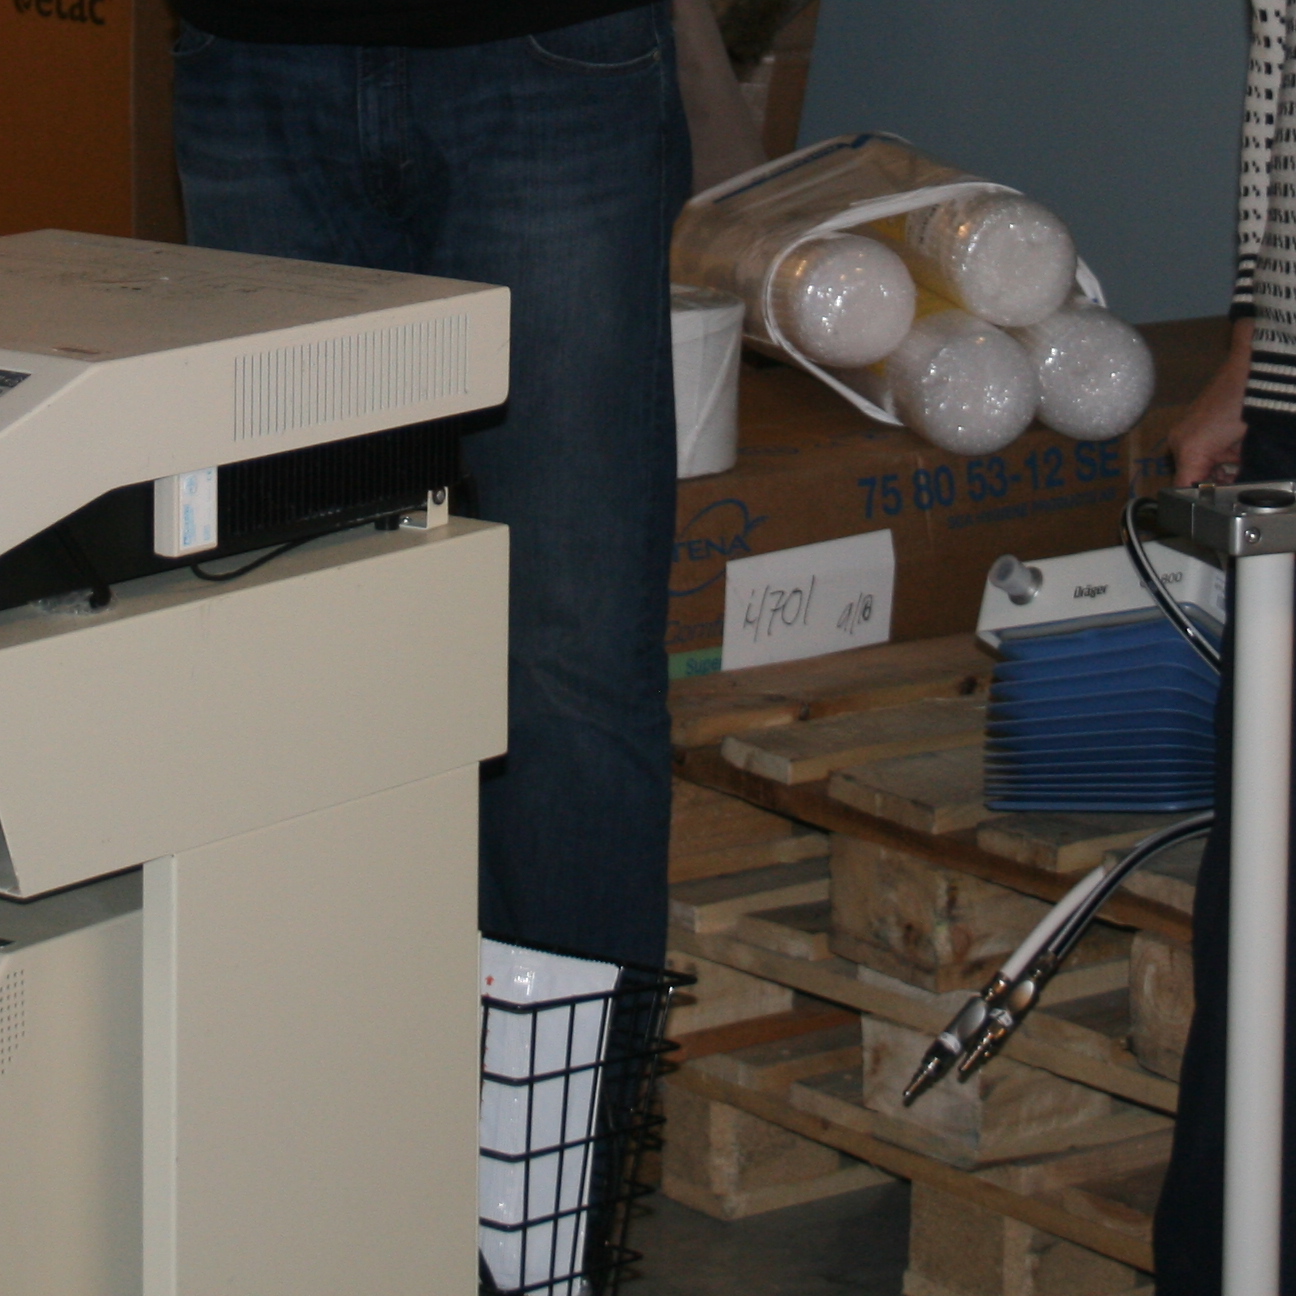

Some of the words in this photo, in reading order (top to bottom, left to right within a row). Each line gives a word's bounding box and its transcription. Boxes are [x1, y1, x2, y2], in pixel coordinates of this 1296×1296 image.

[858, 474, 903, 519] 75
[911, 465, 955, 510] 80
[967, 447, 1066, 502] 53-12
[1074, 439, 1121, 485] SE
[1072, 582, 1109, 599] Dräger
